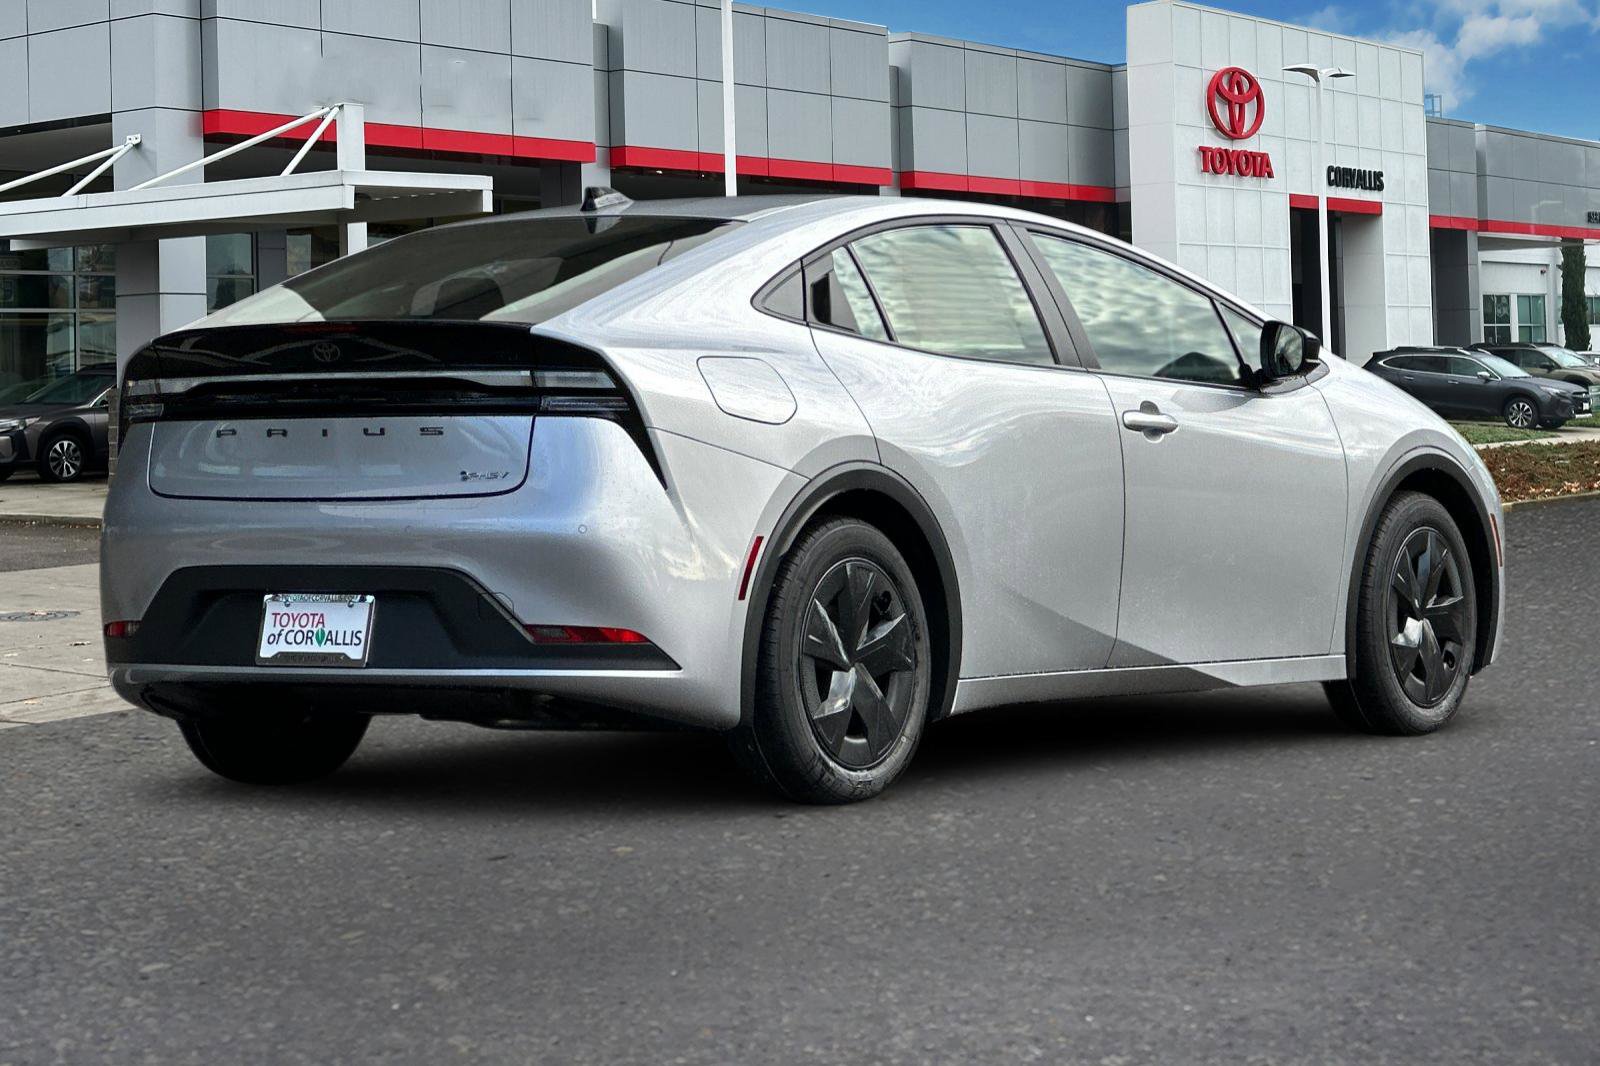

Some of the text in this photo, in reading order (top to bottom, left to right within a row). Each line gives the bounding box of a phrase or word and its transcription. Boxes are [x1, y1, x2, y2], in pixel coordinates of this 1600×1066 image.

[1198, 146, 1275, 178] TOYOTA
[1327, 165, 1385, 191] CORVALLIS
[216, 426, 444, 437] PRIUS
[272, 612, 325, 628] TOYOTA
[267, 629, 285, 645] of
